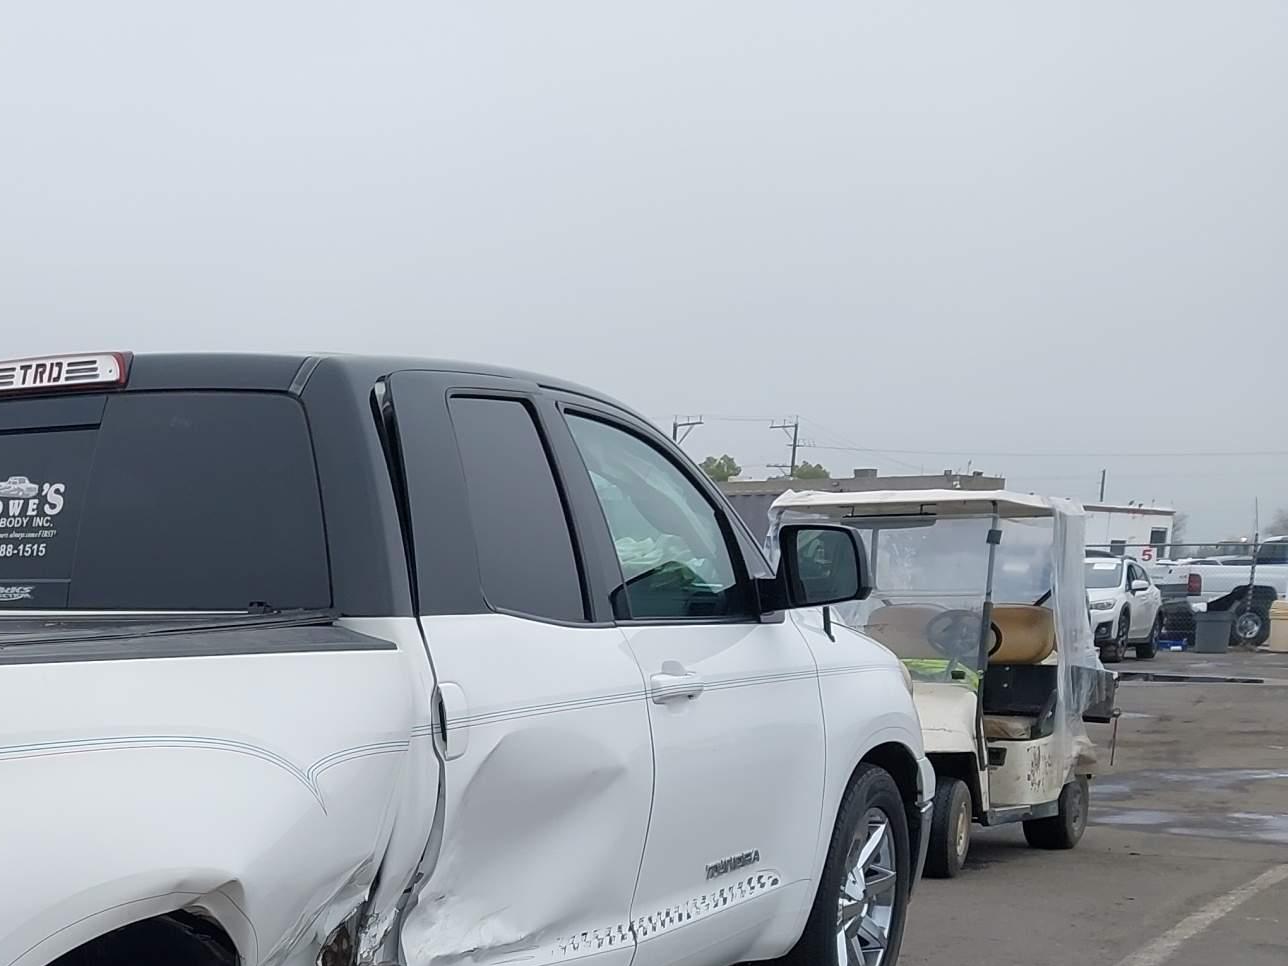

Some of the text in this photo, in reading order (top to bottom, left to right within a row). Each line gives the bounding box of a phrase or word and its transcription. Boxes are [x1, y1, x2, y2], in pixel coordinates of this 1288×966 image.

[20, 361, 63, 385] TRD
[0, 517, 30, 528] BODY
[32, 516, 54, 527] INC.
[1141, 549, 1153, 562] 5
[705, 849, 760, 880] TUNDRA
